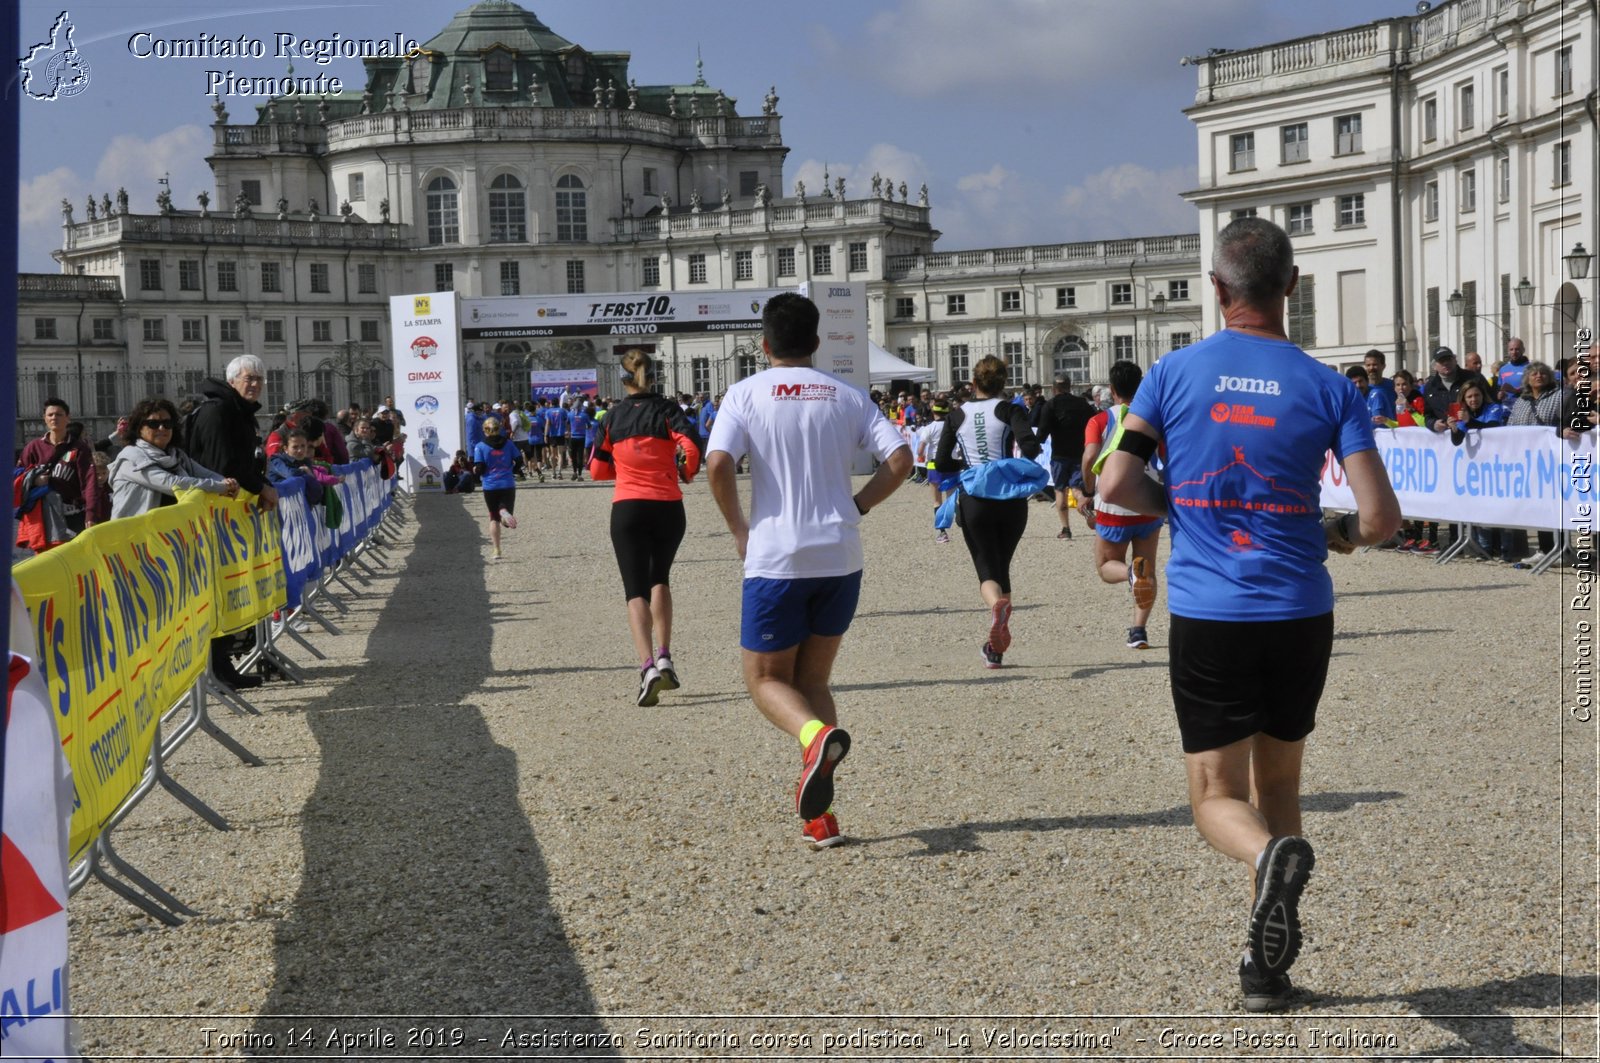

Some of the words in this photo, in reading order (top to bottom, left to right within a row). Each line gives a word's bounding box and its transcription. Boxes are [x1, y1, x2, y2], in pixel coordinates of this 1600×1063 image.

[610, 324, 658, 335] ARRIVO
[707, 322, 763, 331] #SOSTIENICAND
[480, 329, 554, 338] #SOSTIENICANDIOLO
[408, 371, 442, 382] GIMAX
[1232, 404, 1255, 415] TEAM
[1230, 413, 1277, 428] MARATHON
[974, 411, 991, 464] ARUNNER
[1383, 448, 1438, 493] YBRID
[1453, 447, 1531, 499] Central
[1174, 497, 1307, 513] #CORRIPERLARICERCA
[0, 967, 61, 1040] ALI
